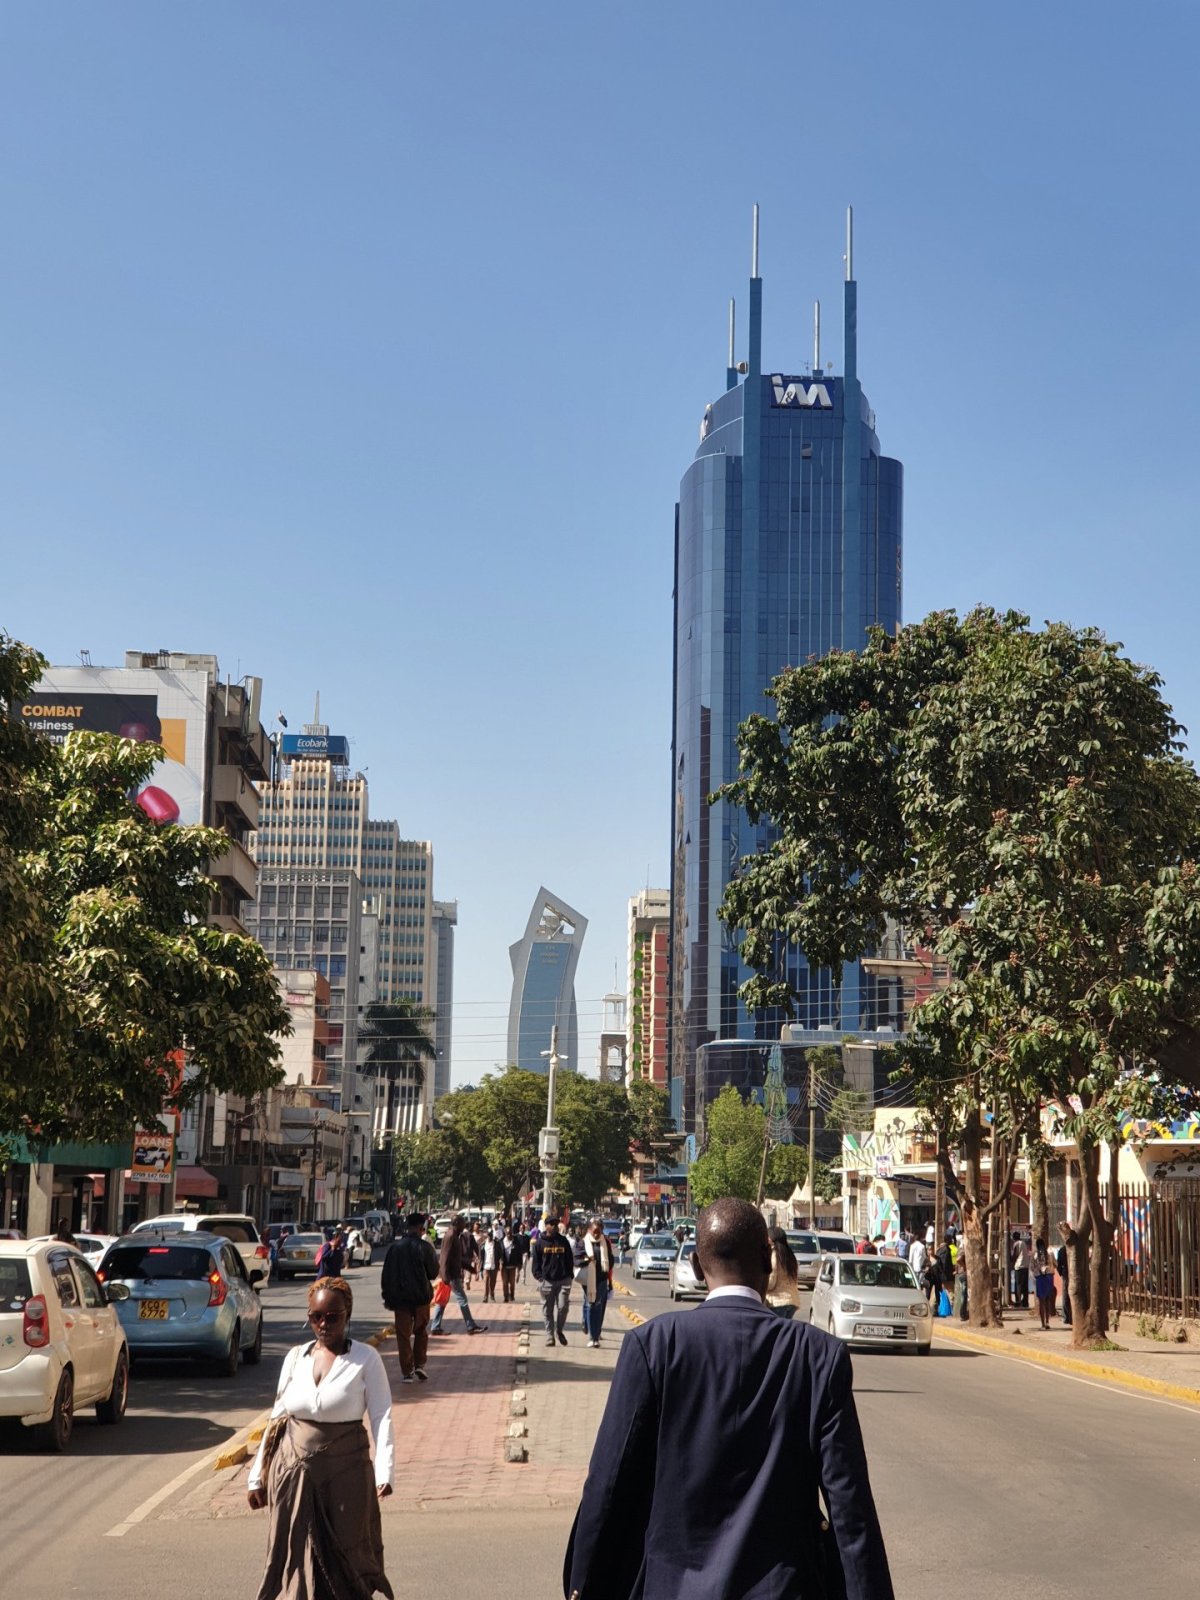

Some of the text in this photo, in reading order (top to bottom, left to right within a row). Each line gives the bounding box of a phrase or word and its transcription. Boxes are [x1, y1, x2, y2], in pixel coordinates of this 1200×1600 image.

[22, 705, 83, 717] COMBAT
[22, 720, 74, 730] usiness
[297, 738, 328, 748] Ecobank
[135, 1136, 173, 1147] LOANS
